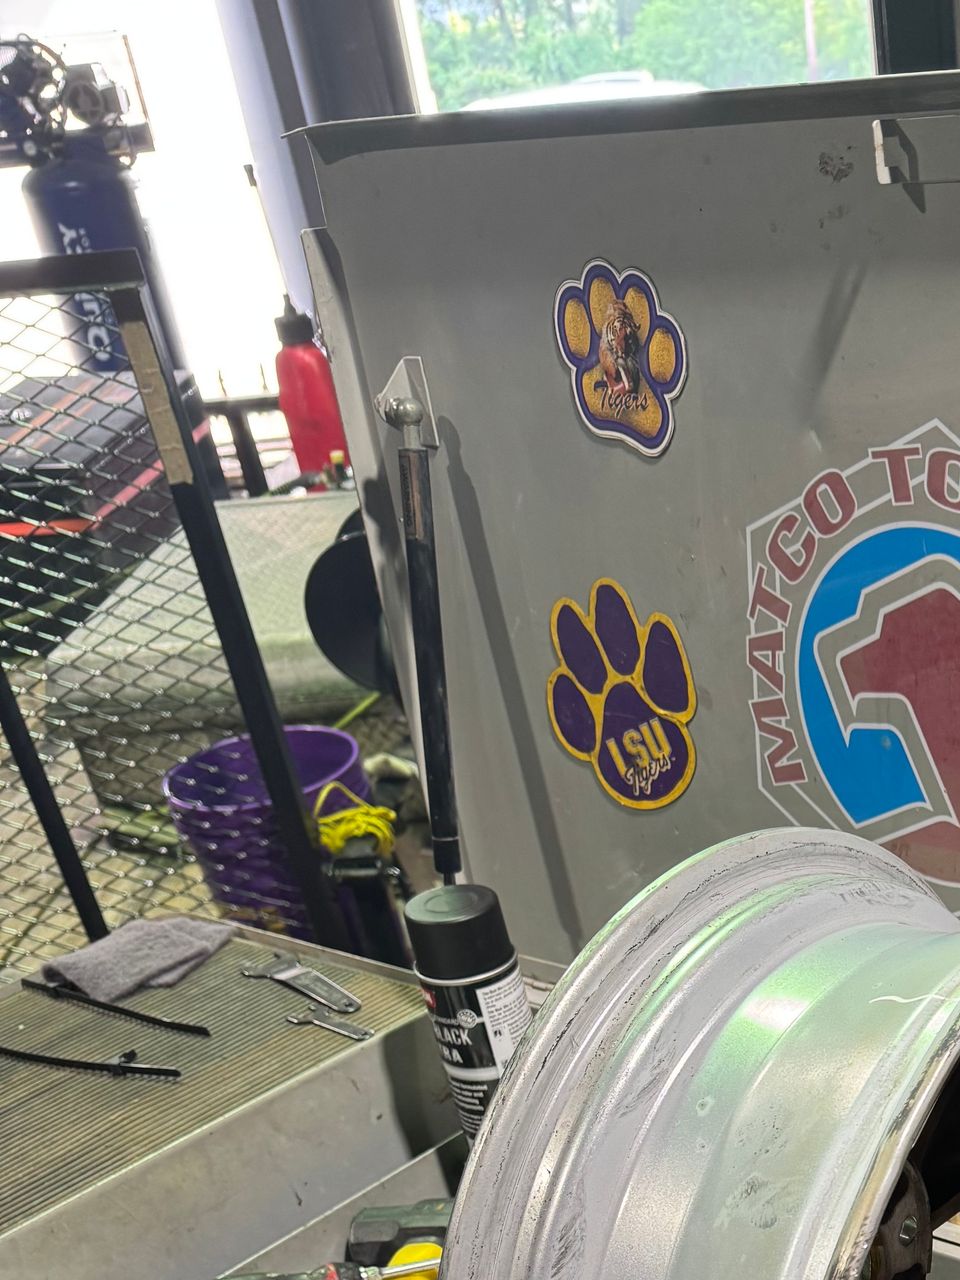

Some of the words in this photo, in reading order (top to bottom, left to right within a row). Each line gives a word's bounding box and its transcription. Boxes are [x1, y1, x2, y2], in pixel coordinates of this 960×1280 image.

[593, 380, 649, 419] Tigers
[747, 468, 858, 785] MATCO
[605, 716, 672, 779] LSU
[624, 751, 672, 796] Tigers
